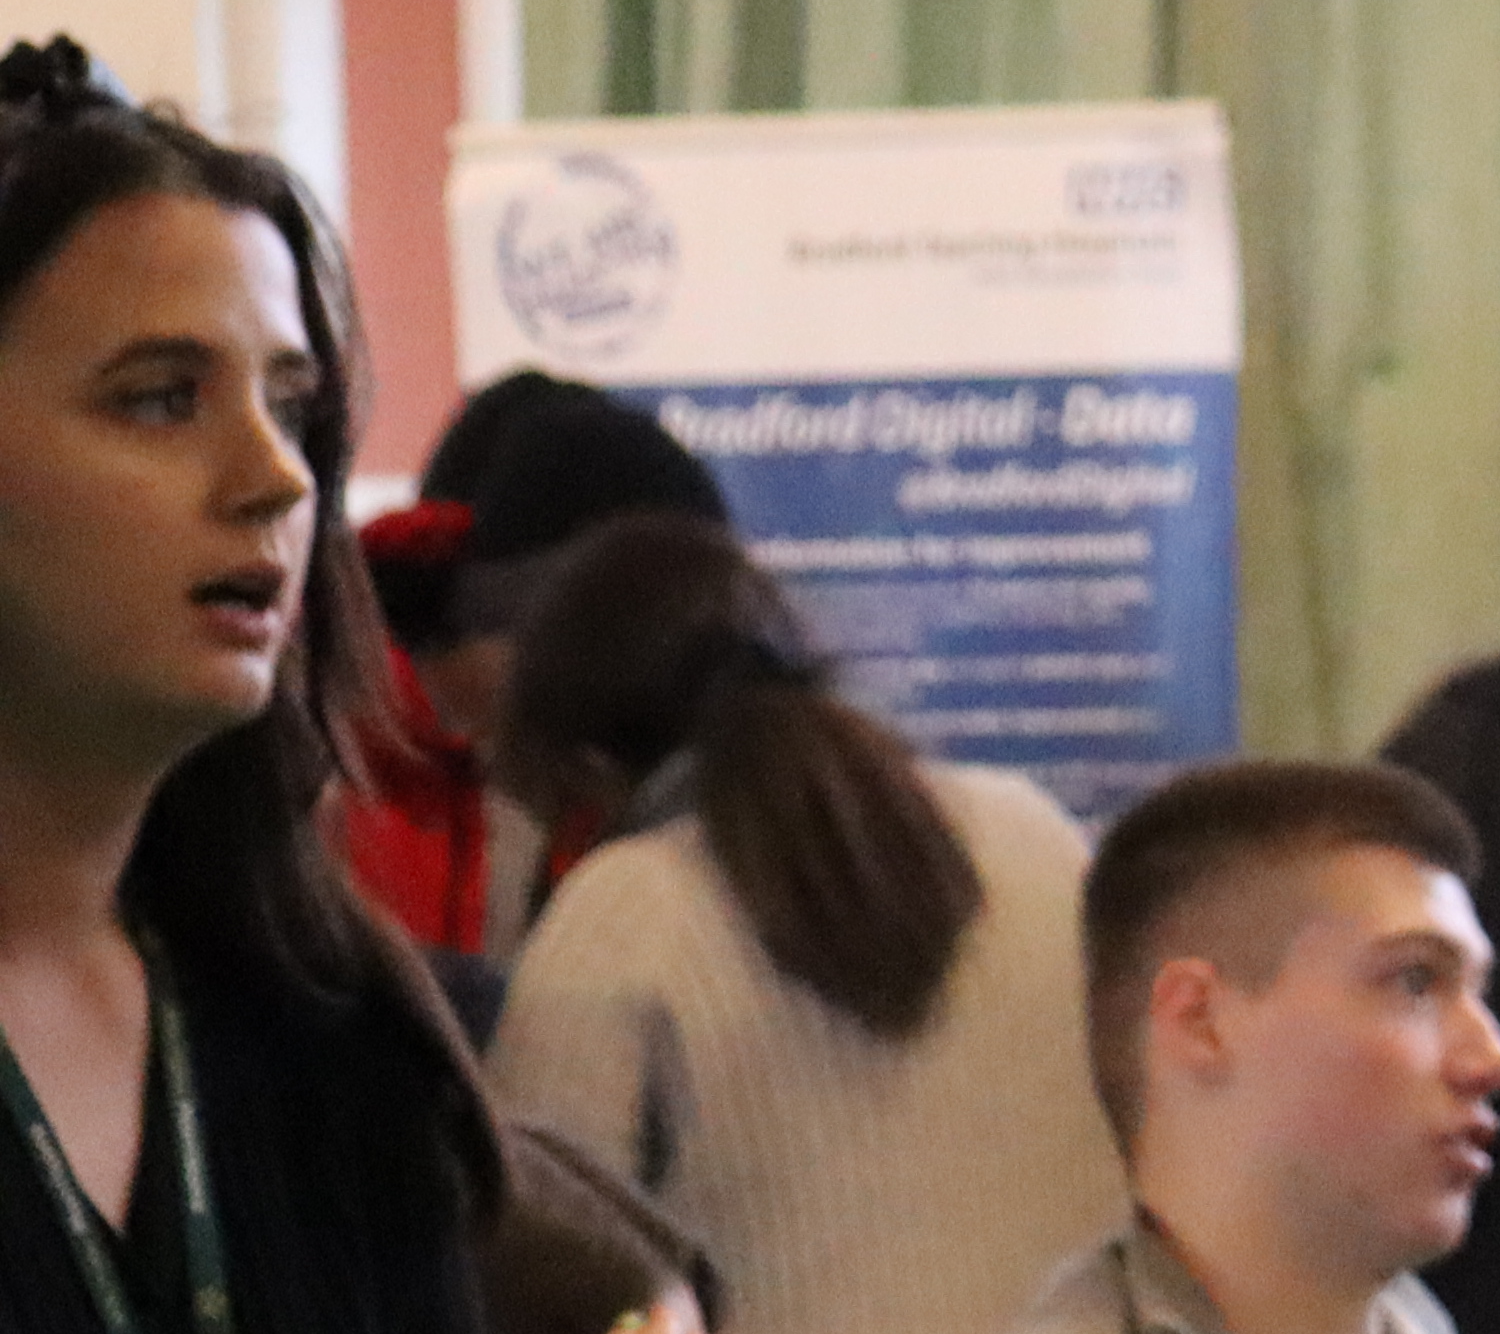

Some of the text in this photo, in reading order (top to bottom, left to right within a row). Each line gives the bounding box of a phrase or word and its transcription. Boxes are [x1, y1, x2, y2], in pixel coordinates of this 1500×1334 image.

[660, 389, 866, 457] Bradford
[872, 385, 1036, 465] Digital
[1062, 383, 1196, 447] Data
